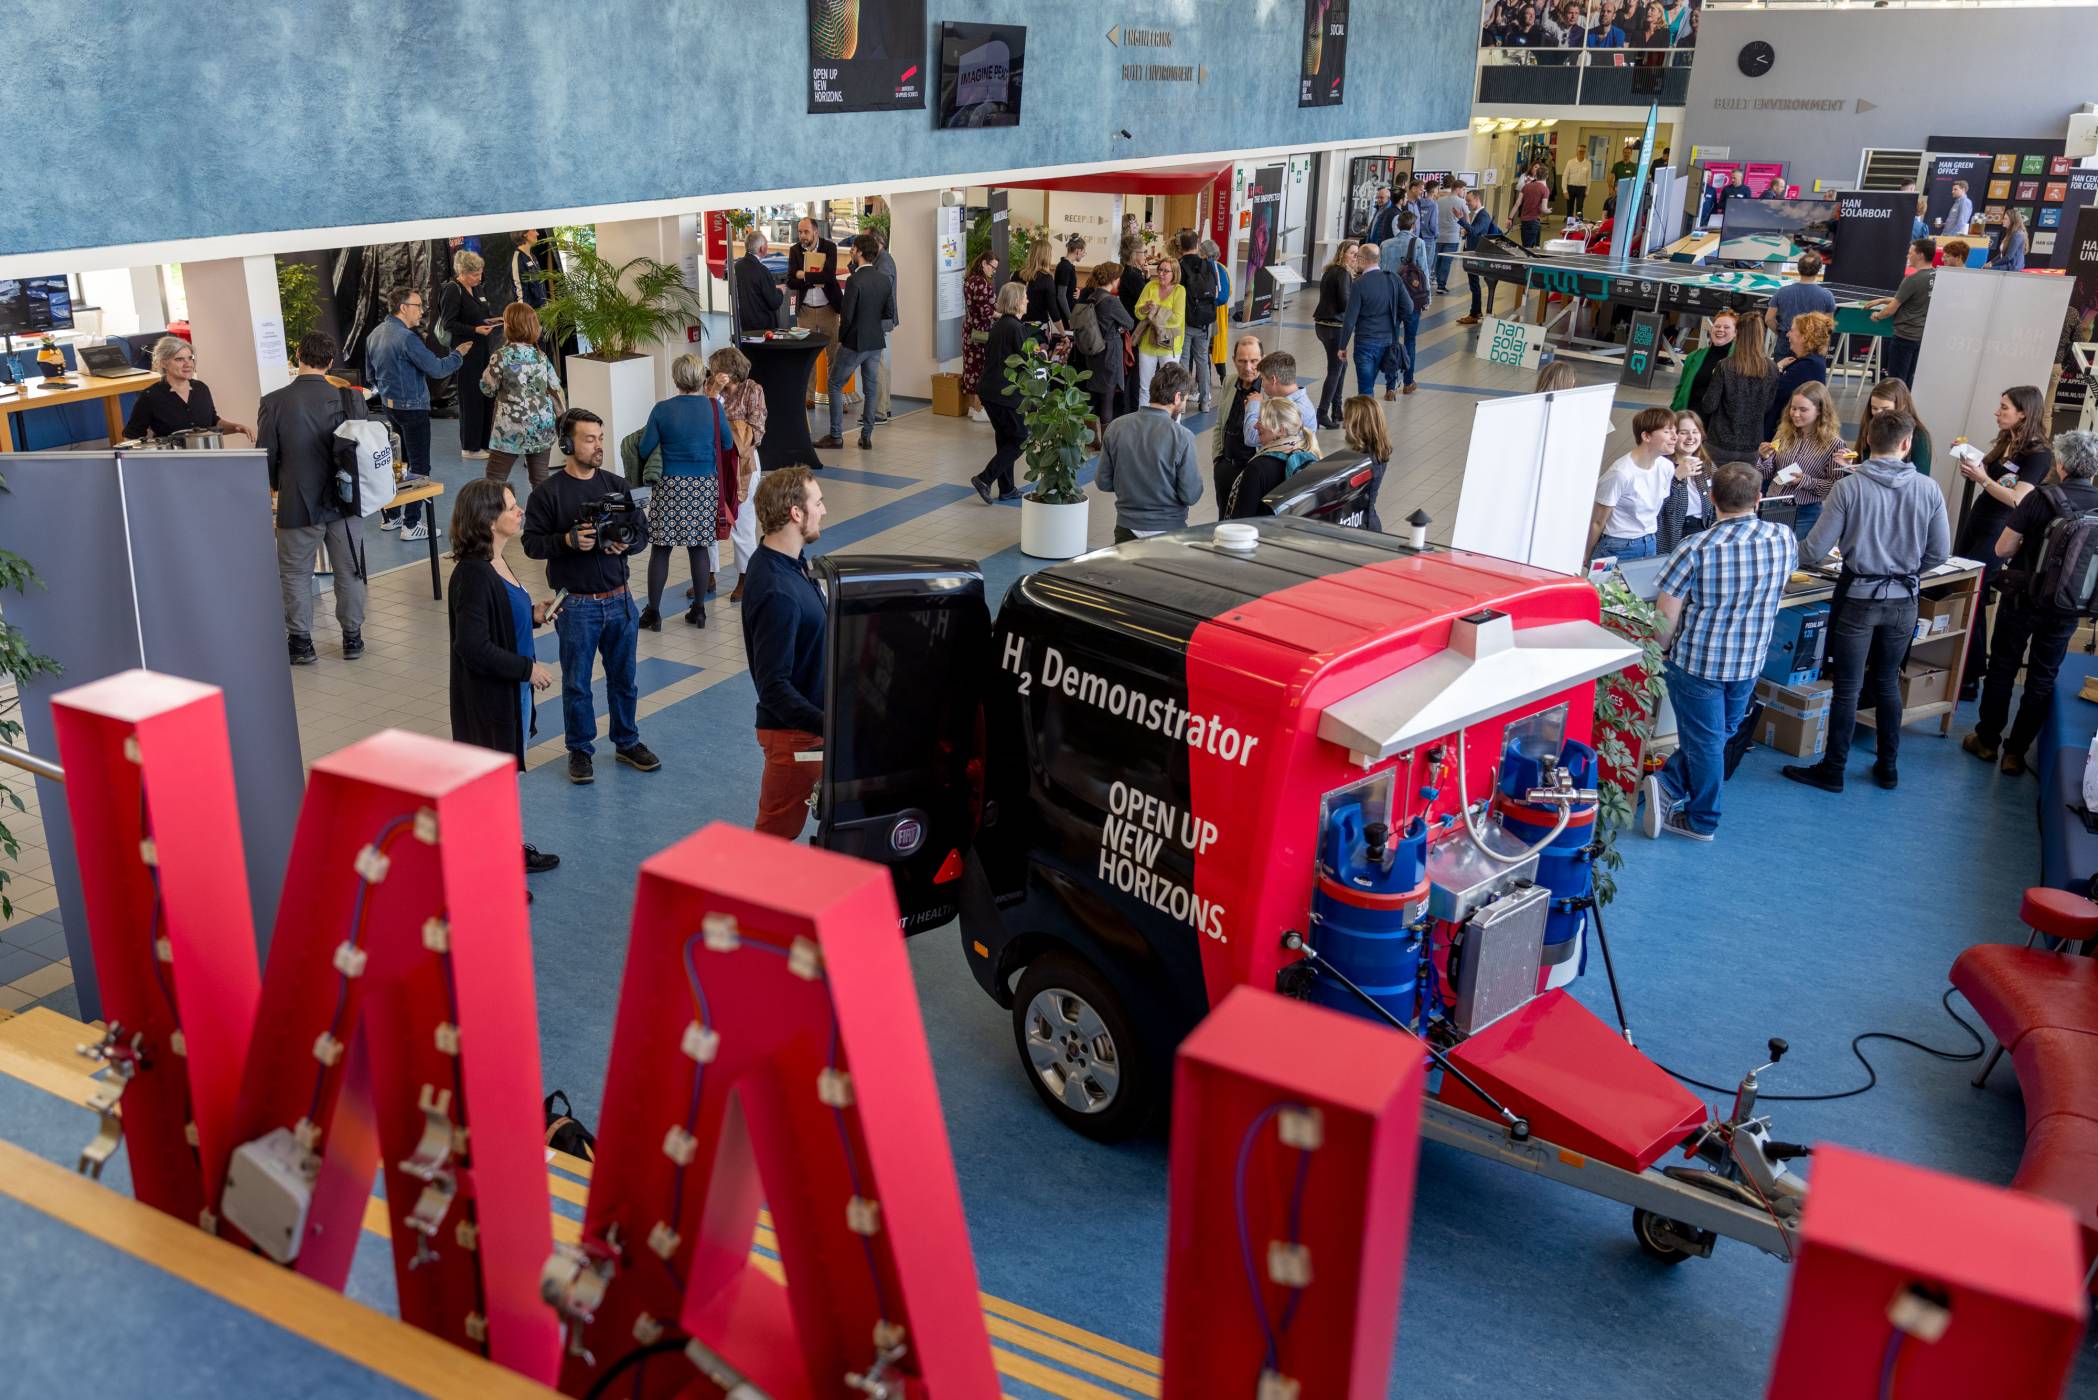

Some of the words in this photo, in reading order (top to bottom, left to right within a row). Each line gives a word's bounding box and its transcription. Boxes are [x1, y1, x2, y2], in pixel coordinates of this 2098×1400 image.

[1123, 28, 1173, 48] ENGINEERING
[813, 68, 829, 80] OPEN
[829, 68, 838, 80] UP
[1145, 63, 1193, 82] ENVIRONMENT
[813, 80, 827, 91] NEW
[814, 91, 844, 102] HORIZONS.
[1713, 97, 1750, 111] BUILT
[1753, 98, 1846, 113] ENVIRONMENT
[1938, 161, 1954, 169] HAN
[1953, 161, 1974, 170] GREEN
[2071, 182, 2082, 190] FOR
[2072, 174, 2086, 182] HAN
[1218, 190, 1227, 231] RECEPTIE
[1842, 199, 1862, 209] HAN
[1840, 208, 1893, 218] SOLARBOAT
[2082, 239, 2098, 251] HA
[1495, 319, 1525, 339] han
[1493, 335, 1528, 353] solar
[1489, 342, 1524, 367] boat
[373, 446, 391, 460] Gab
[374, 456, 391, 469] bag
[1041, 646, 1259, 768] Demonstrator
[1109, 781, 1176, 840] OPEN
[1180, 811, 1219, 855] UP
[898, 828, 917, 844] FIAT
[1102, 814, 1164, 869] NEW
[1098, 847, 1228, 944] HORIZONS.
